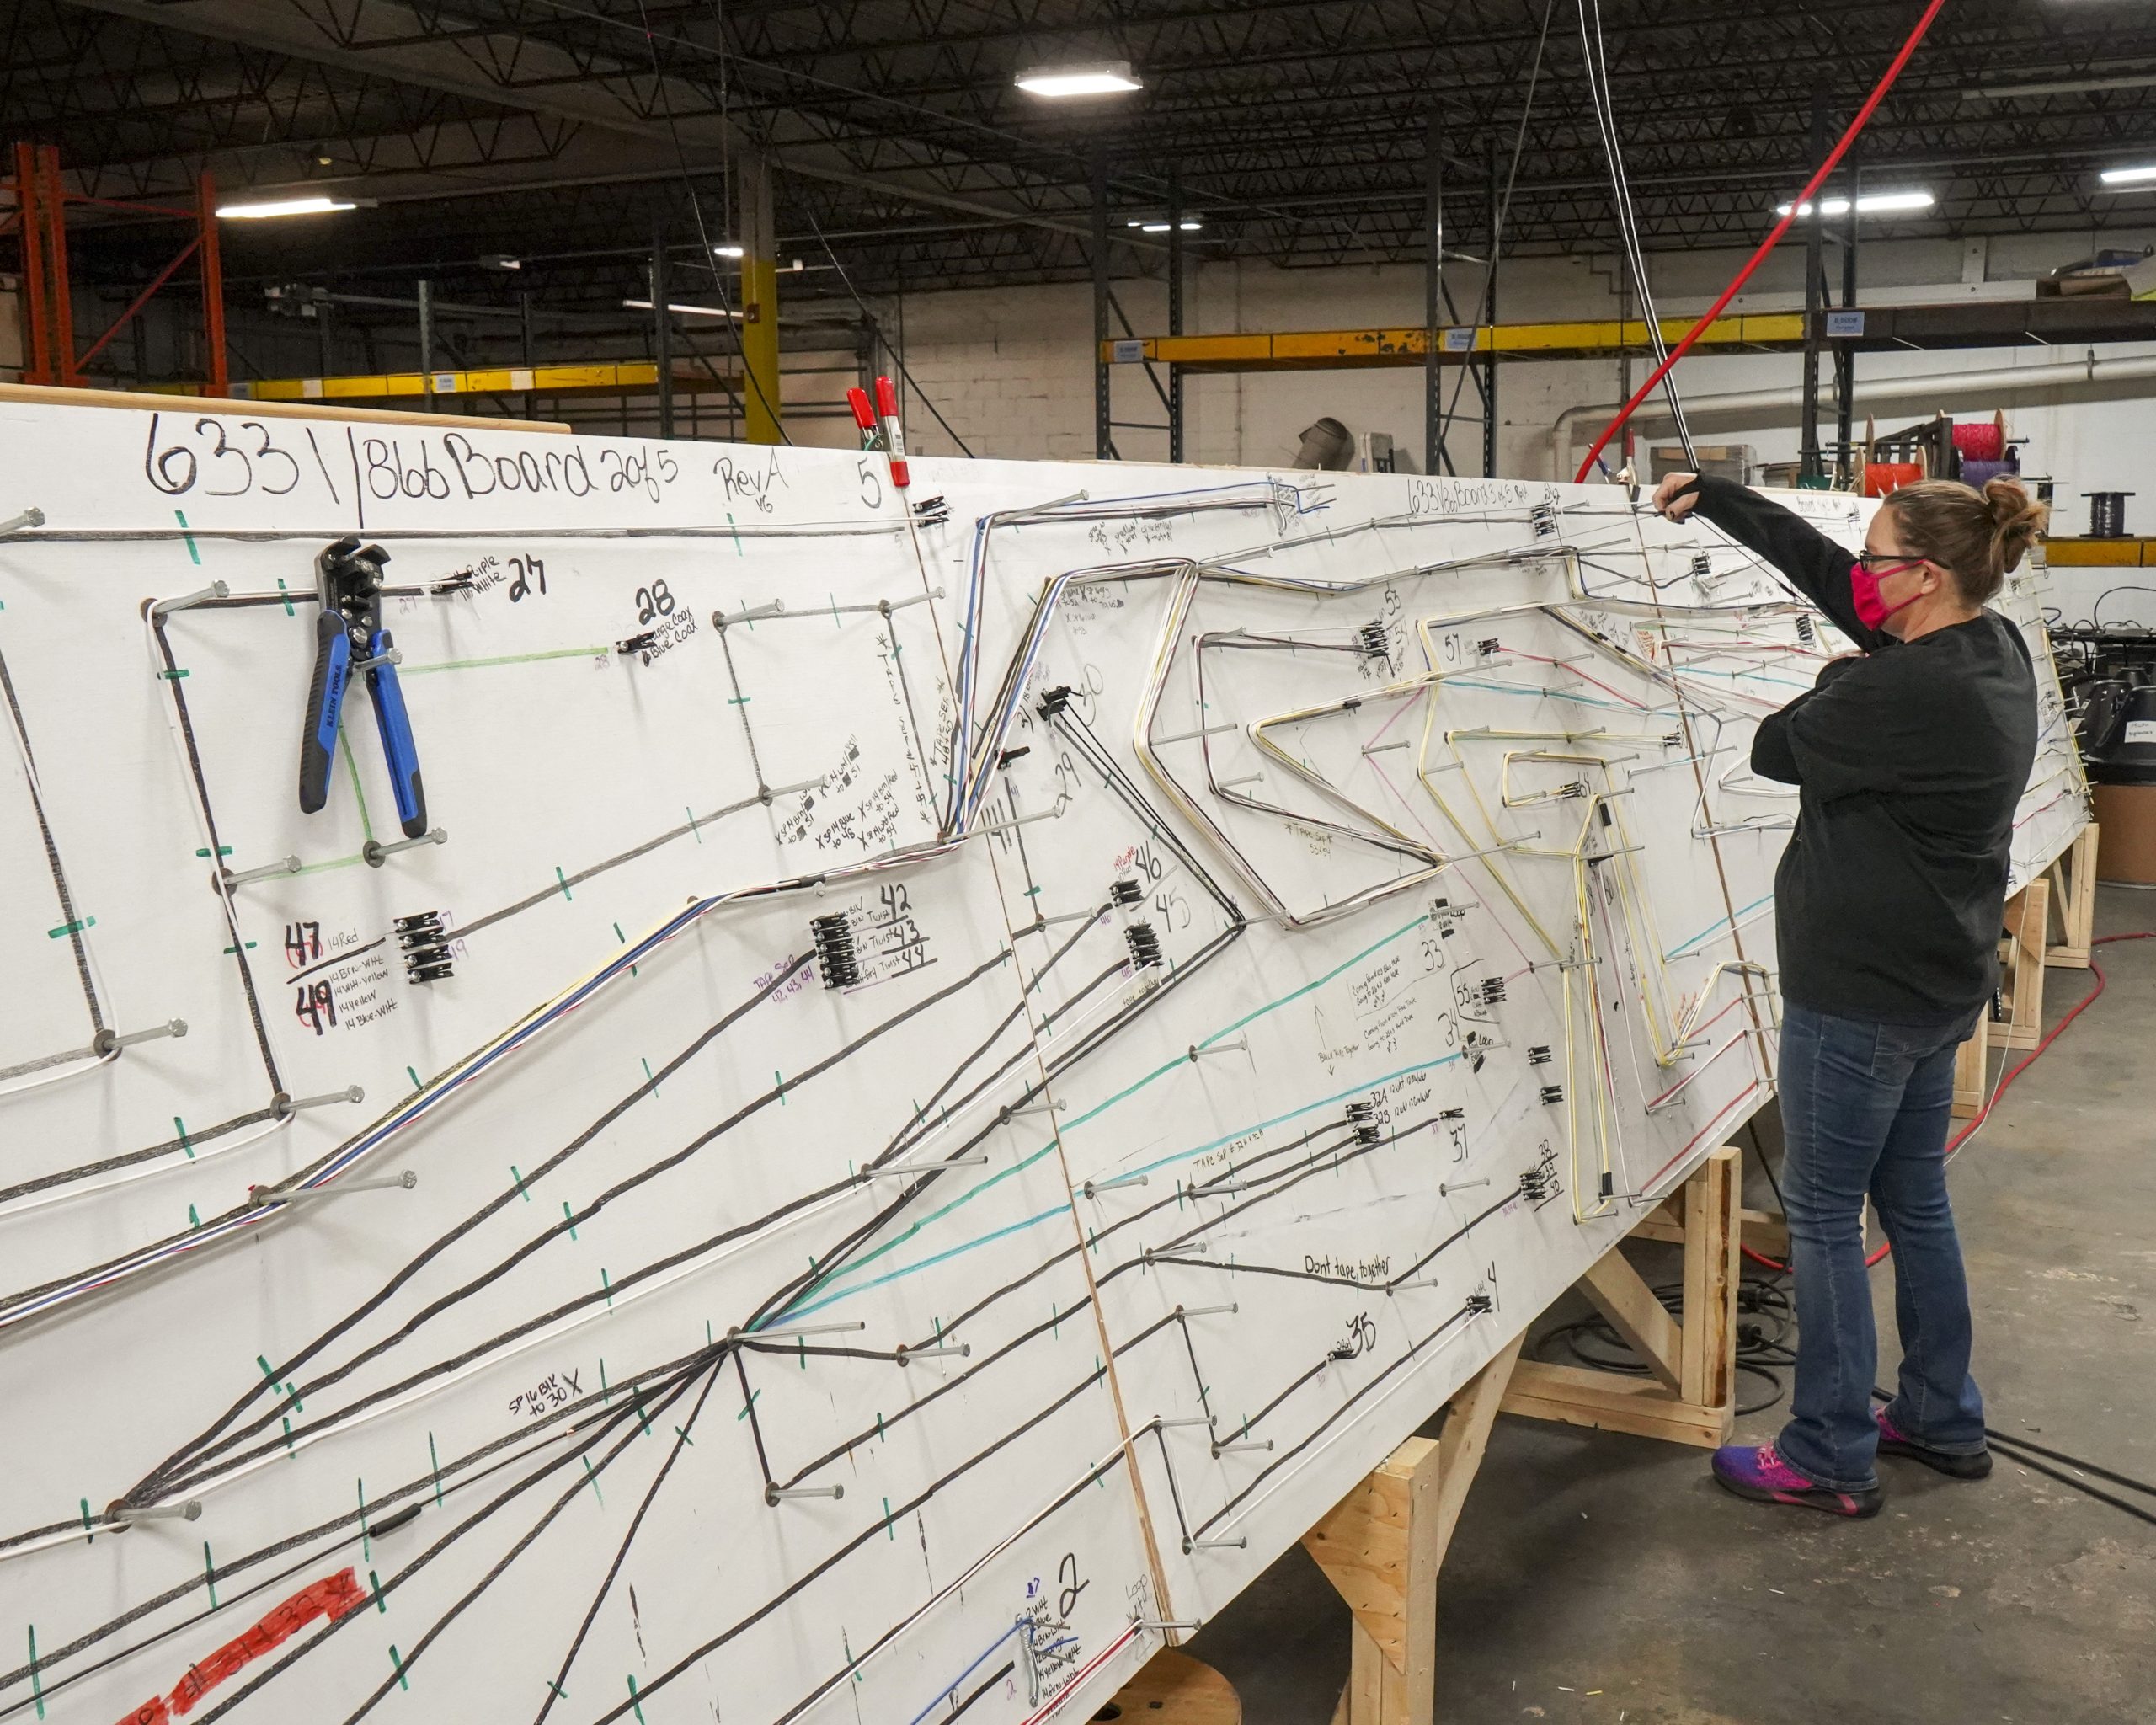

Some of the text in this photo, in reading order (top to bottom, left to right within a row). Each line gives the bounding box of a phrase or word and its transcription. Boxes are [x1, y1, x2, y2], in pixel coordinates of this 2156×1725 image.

[444, 432, 600, 499] Board
[857, 455, 882, 509] 5
[508, 553, 547, 604] 27
[635, 579, 676, 626] 28
[1385, 582, 1401, 617] 53
[1395, 620, 1410, 646] 54
[1444, 633, 1462, 665] 57
[326, 697, 337, 728] KLEIN
[1054, 750, 1082, 816] 29
[841, 827, 856, 840] 48
[1135, 840, 1162, 884] 46
[881, 882, 913, 920] 42
[893, 919, 921, 947] 43
[1100, 914, 1112, 926] 46
[284, 921, 320, 967] 47
[901, 943, 926, 969] 44
[1421, 938, 1444, 971] 33
[800, 965, 815, 984] 44
[295, 979, 337, 1036] 49
[1456, 983, 1470, 1007] 55
[1438, 1007, 1460, 1048] 34
[1369, 1087, 1389, 1109] 32A
[1373, 1108, 1391, 1126] 32B
[1449, 1122, 1469, 1163] 37
[1538, 1139, 1552, 1164] 38
[1487, 1260, 1501, 1313] 4
[1345, 1311, 1376, 1359] 35
[530, 1402, 546, 1417] to
[546, 1386, 568, 1407] 30
[1059, 1552, 1091, 1619] 2
